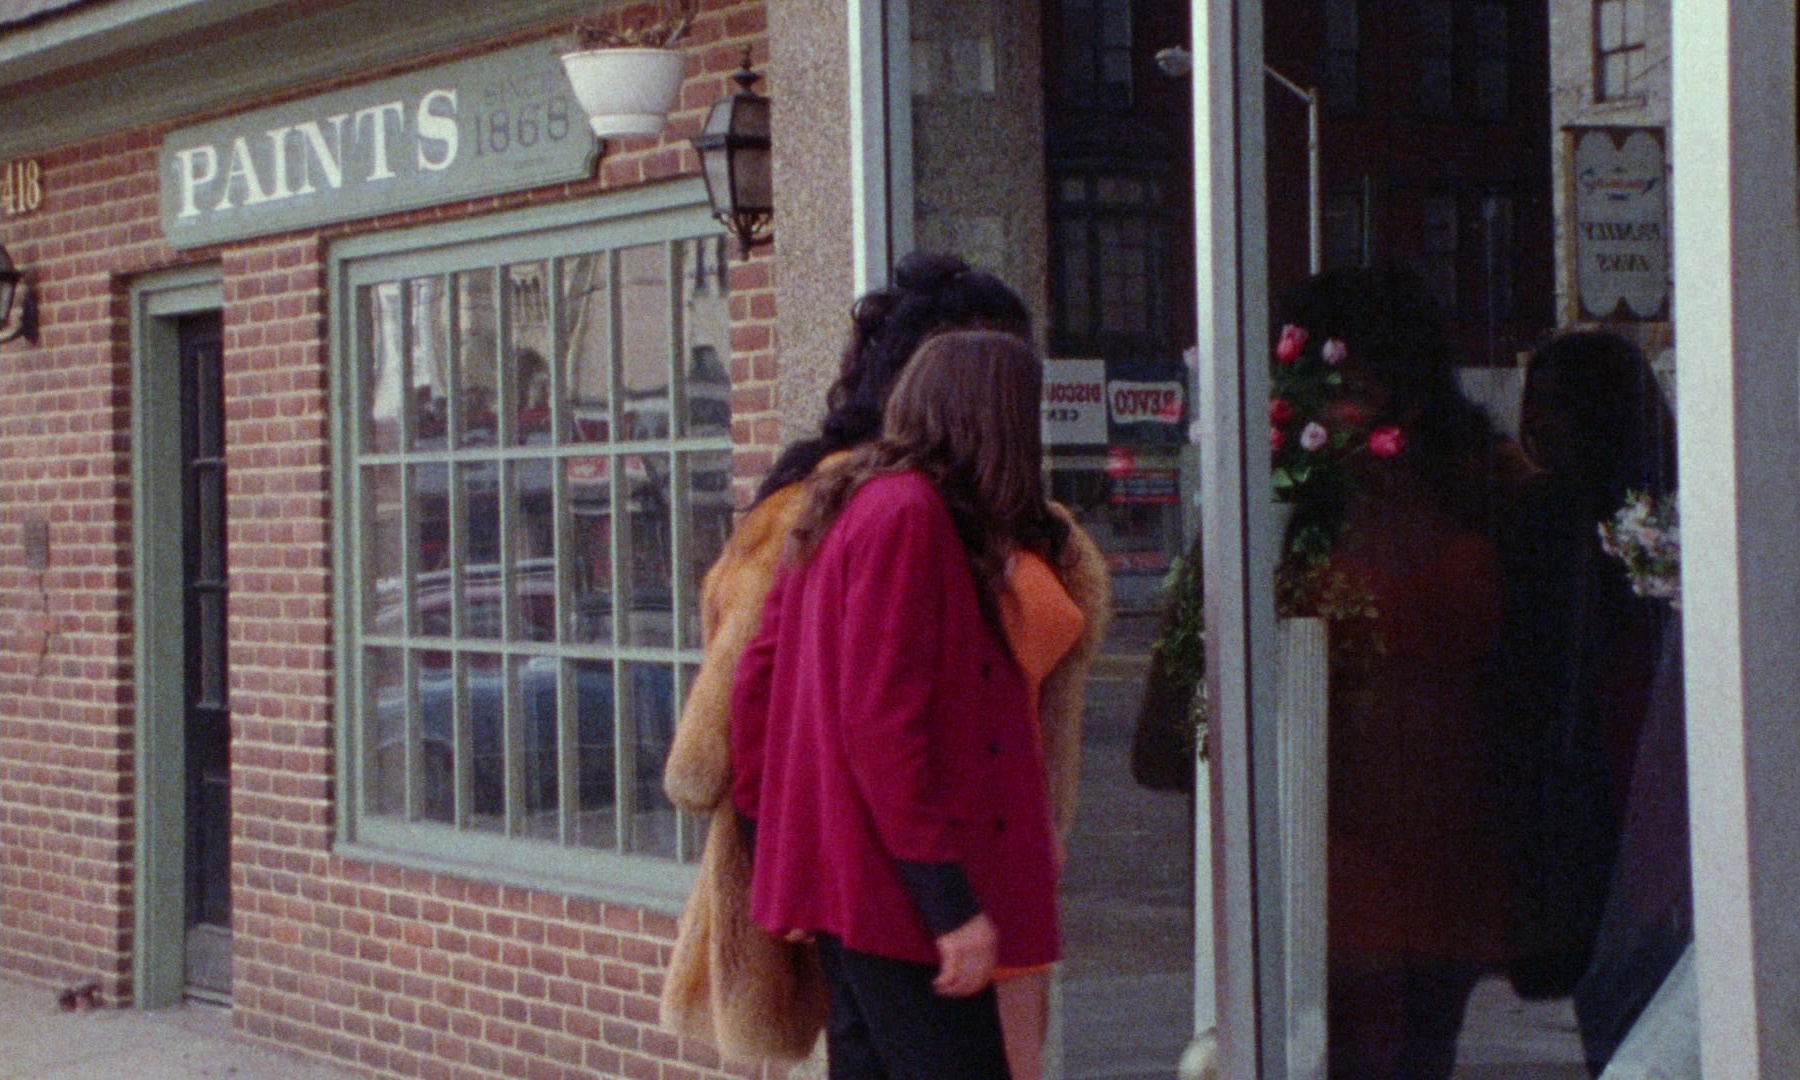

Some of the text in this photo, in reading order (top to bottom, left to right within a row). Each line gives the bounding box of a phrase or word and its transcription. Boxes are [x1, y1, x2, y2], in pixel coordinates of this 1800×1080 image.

[174, 88, 460, 220] PAINTS
[474, 95, 569, 156] 1868
[2, 159, 41, 214] 418
